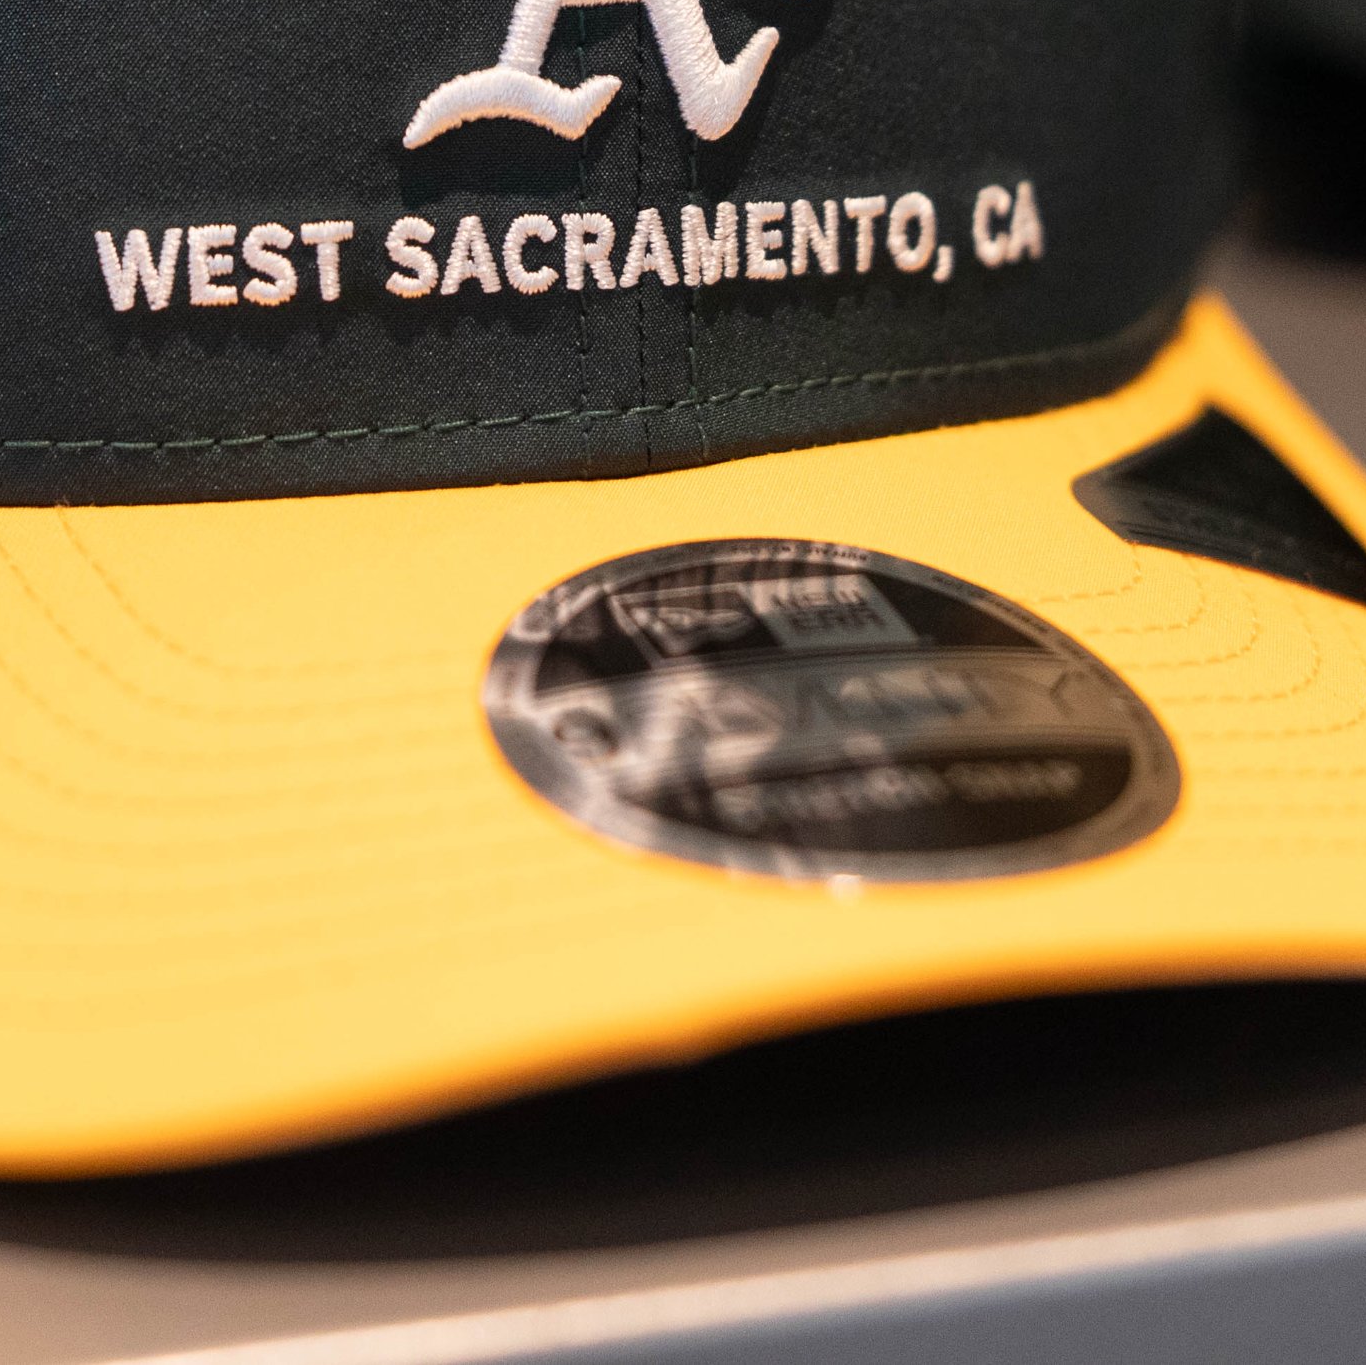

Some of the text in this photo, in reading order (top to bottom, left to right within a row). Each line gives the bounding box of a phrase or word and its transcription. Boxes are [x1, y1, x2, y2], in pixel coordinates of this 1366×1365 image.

[92, 182, 1041, 312] WEST SACRAMENTO, CA
